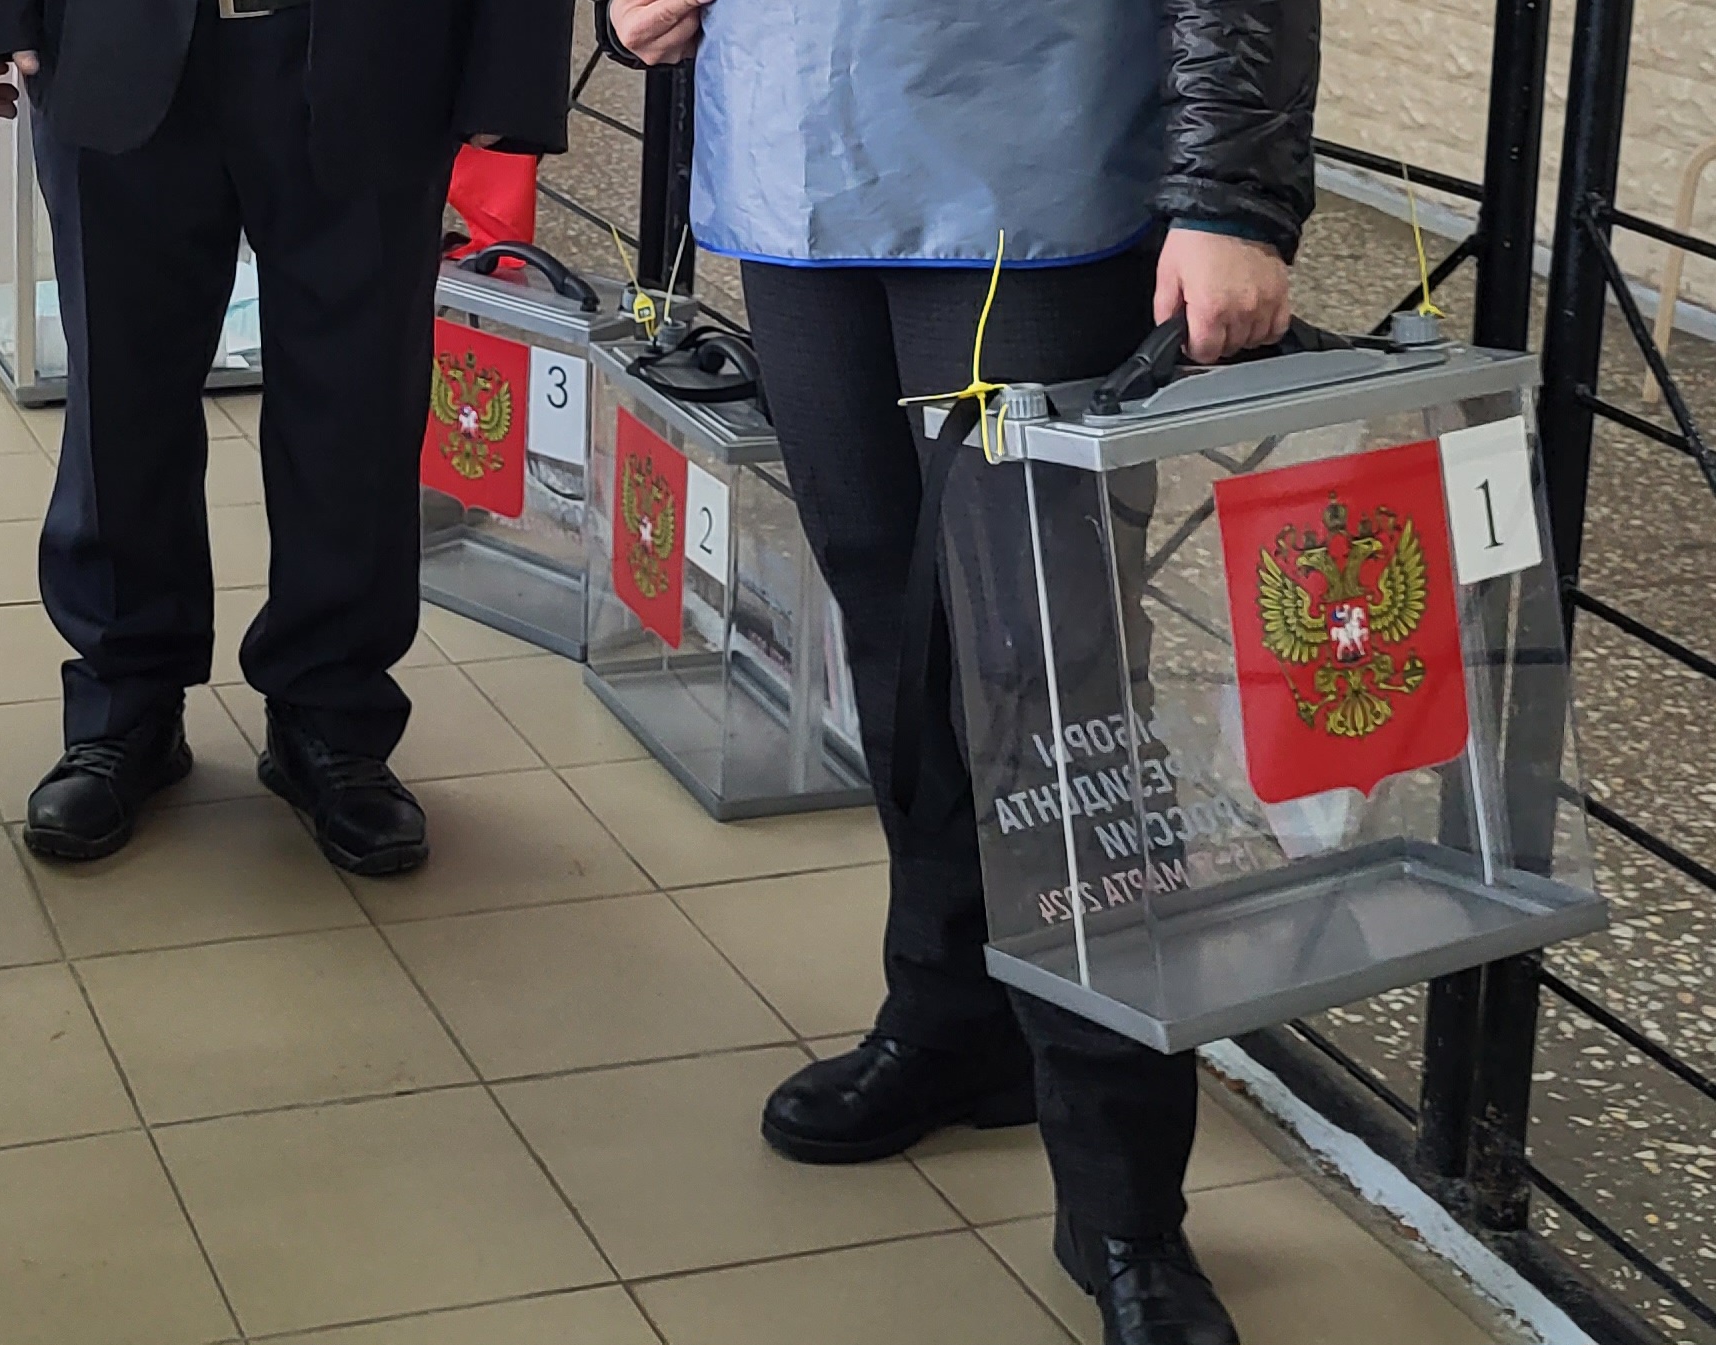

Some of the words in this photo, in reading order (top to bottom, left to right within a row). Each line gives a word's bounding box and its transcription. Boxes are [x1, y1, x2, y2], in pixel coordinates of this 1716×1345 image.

[545, 365, 568, 410] 3
[698, 507, 715, 555] 2
[1474, 478, 1505, 550] 1
